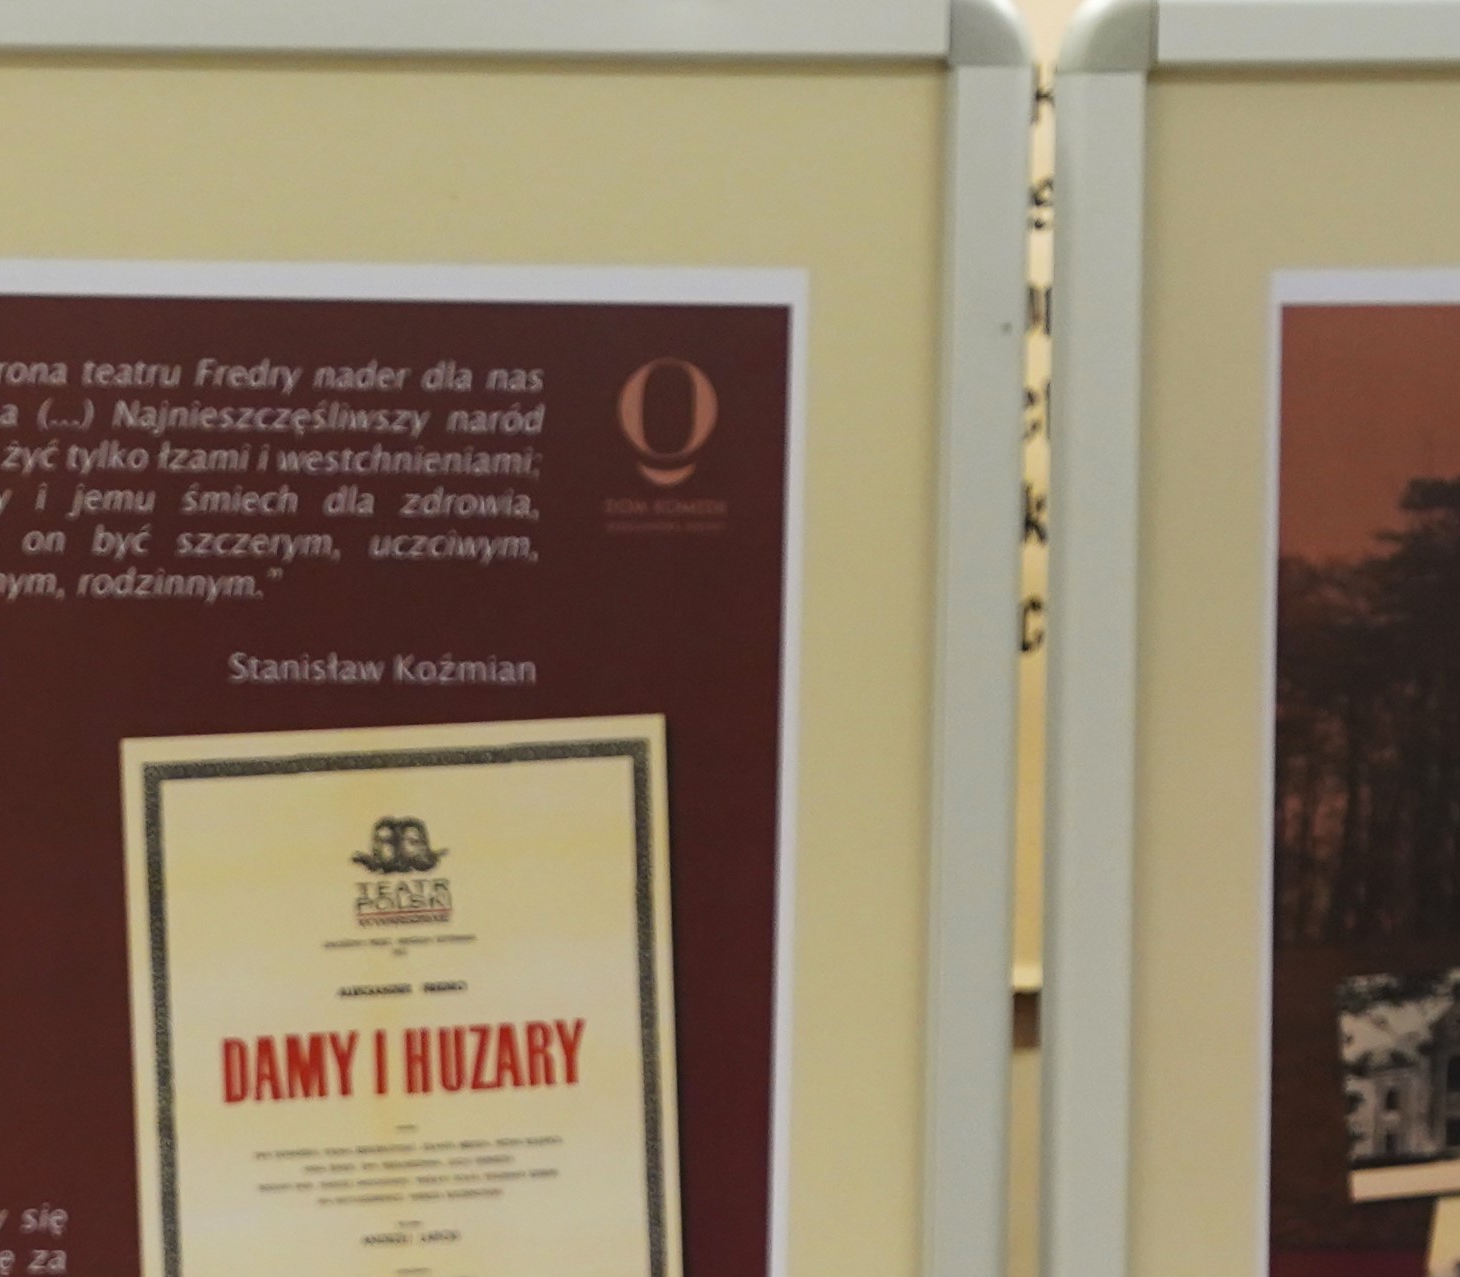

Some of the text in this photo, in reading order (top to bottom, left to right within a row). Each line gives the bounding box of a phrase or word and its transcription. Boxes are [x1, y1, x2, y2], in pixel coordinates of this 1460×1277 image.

[82, 361, 181, 387] teatru
[195, 358, 301, 395] Fredry
[314, 360, 410, 390] nader
[421, 361, 472, 391] dla
[486, 369, 543, 392] nas
[112, 400, 429, 437] Najnieszczęśliwszy
[447, 403, 545, 434] naród
[1, 440, 58, 474] żyć
[67, 440, 149, 474] tylko
[158, 441, 249, 472] łzami
[257, 444, 269, 471] i
[35, 482, 47, 510] i
[69, 483, 155, 518] jemu
[182, 483, 298, 514] śmiech
[323, 485, 374, 515] dla
[400, 487, 539, 519] zdrowia,
[22, 531, 66, 553] on
[92, 524, 150, 559] być
[177, 533, 340, 561] szczerym,
[370, 535, 538, 563] uczciwym,
[229, 652, 536, 684] Stanisław Koźmian
[355, 878, 451, 897] TEATR
[223, 1021, 583, 1103] DAMY I HUZARY
[22, 1209, 68, 1235] się
[28, 1250, 66, 1273] za
